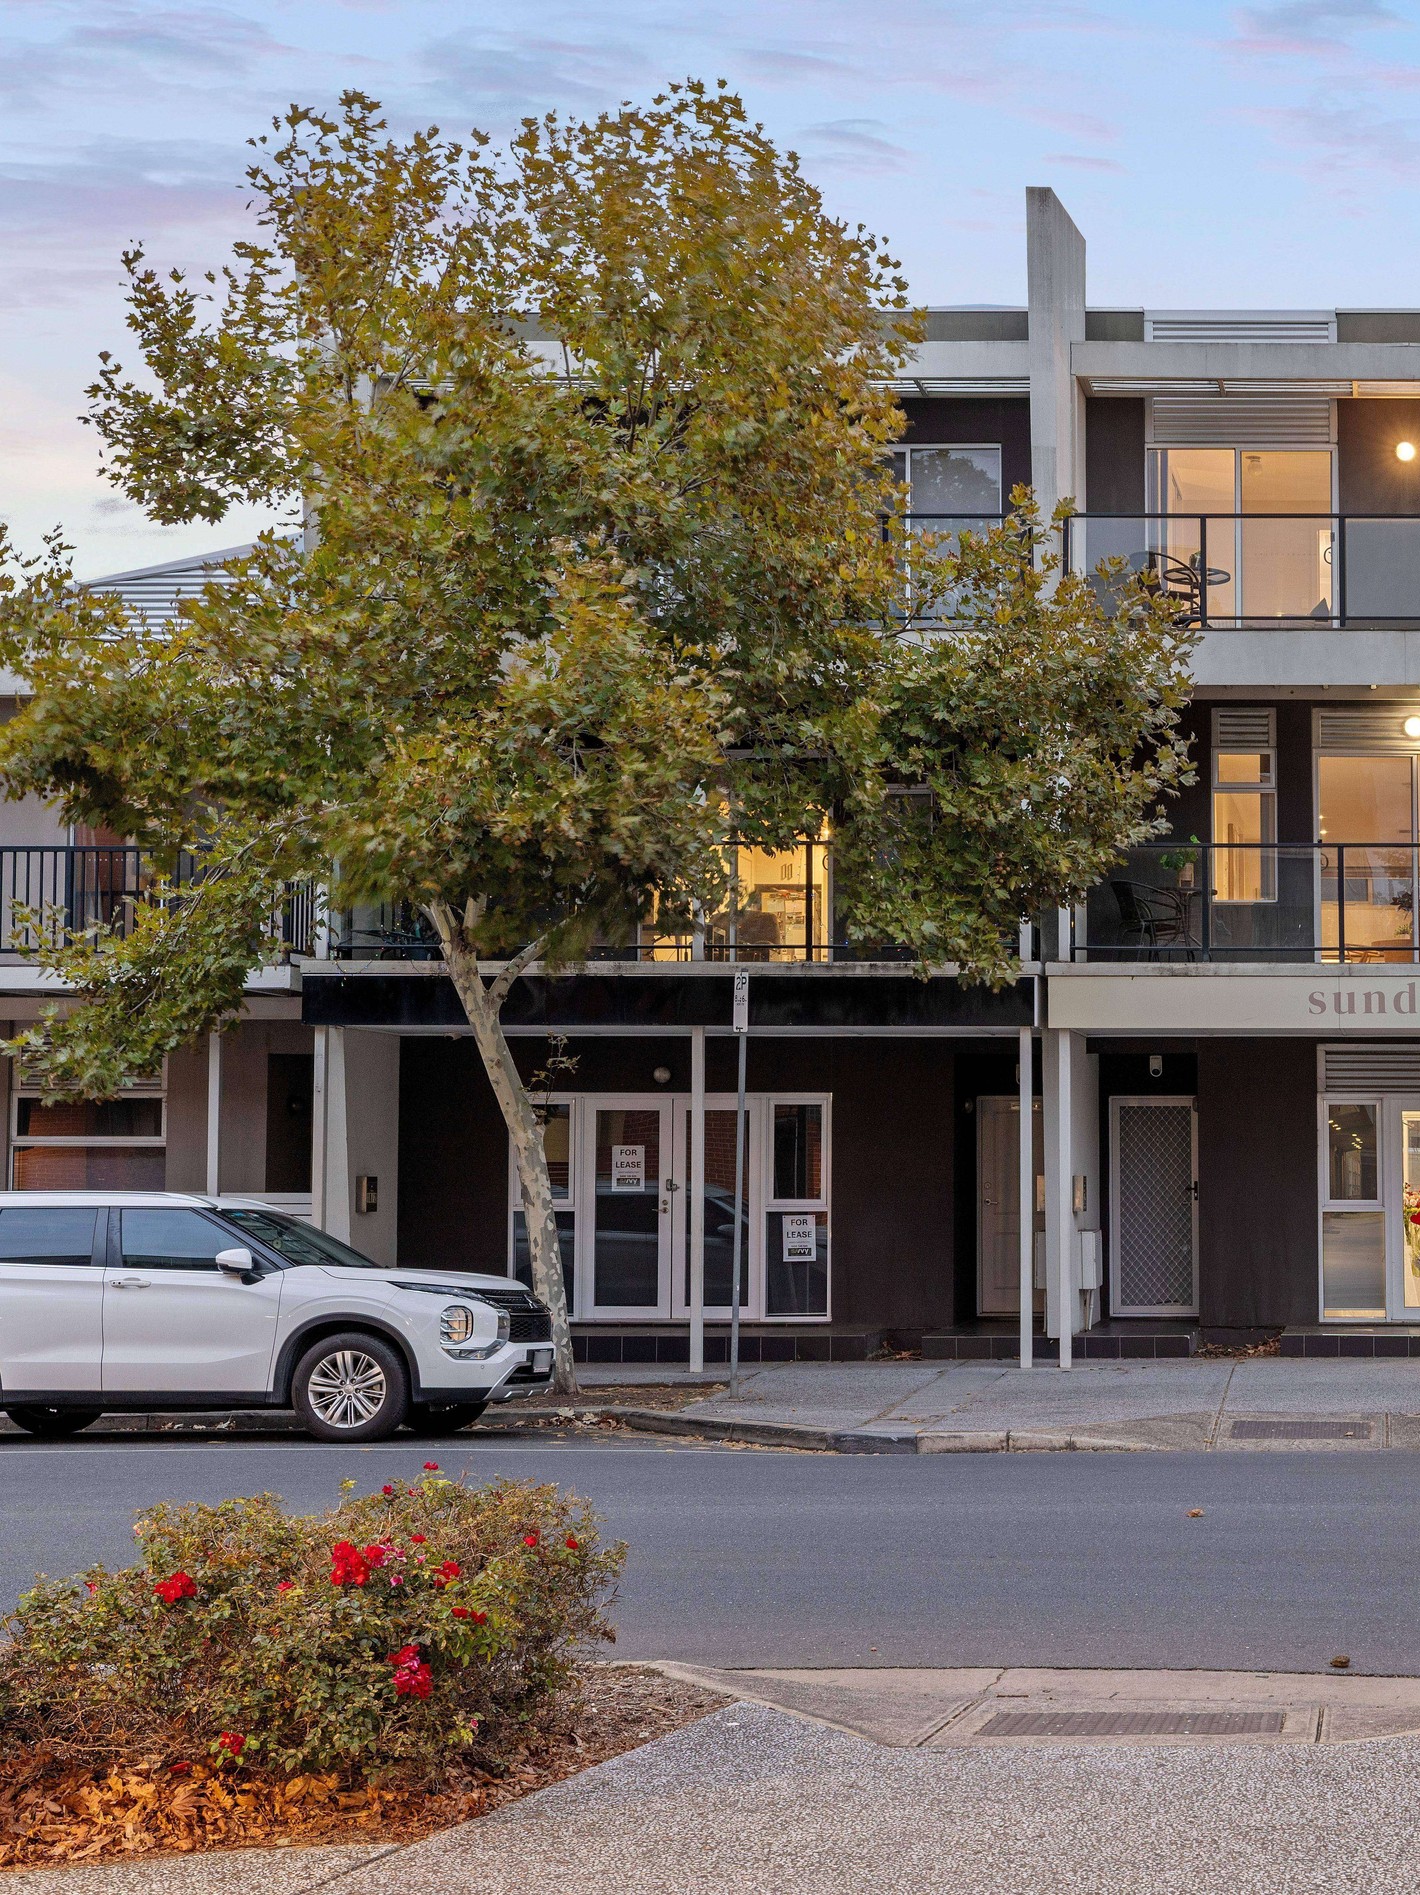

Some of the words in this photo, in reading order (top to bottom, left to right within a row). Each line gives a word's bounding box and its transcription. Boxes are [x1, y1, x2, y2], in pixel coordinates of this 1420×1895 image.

[735, 976, 748, 991] 2P
[619, 1148, 637, 1156] FOR
[615, 1161, 642, 1169] LEASE
[790, 1218, 808, 1226] FOR
[786, 1231, 813, 1239] LEASE
